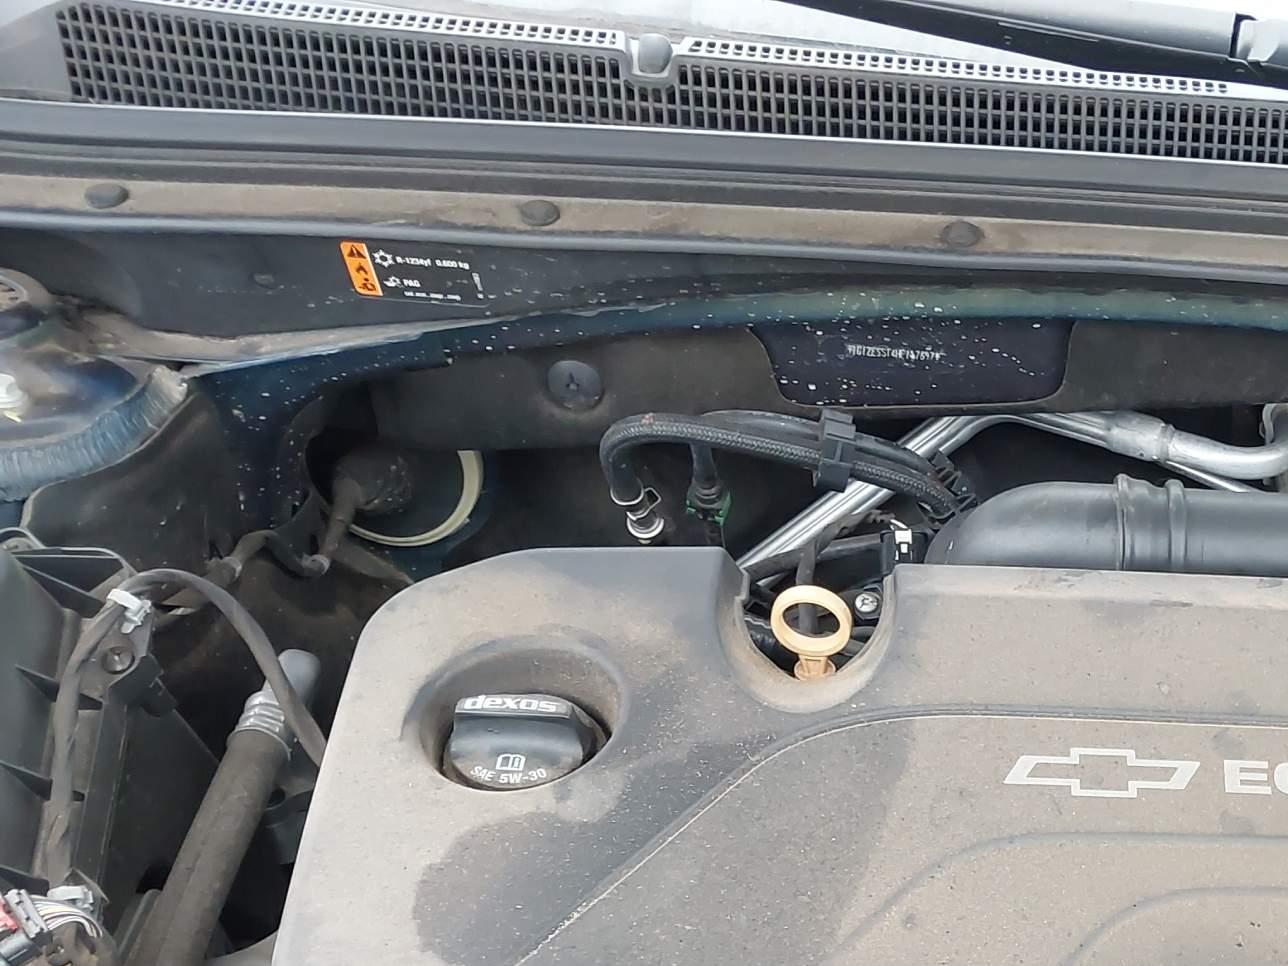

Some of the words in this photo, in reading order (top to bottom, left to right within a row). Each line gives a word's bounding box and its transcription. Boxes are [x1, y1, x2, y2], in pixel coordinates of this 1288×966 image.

[402, 278, 421, 288] PAG
[462, 695, 562, 713] dexos
[470, 765, 496, 782] SAE
[498, 767, 547, 784] 5W-30
